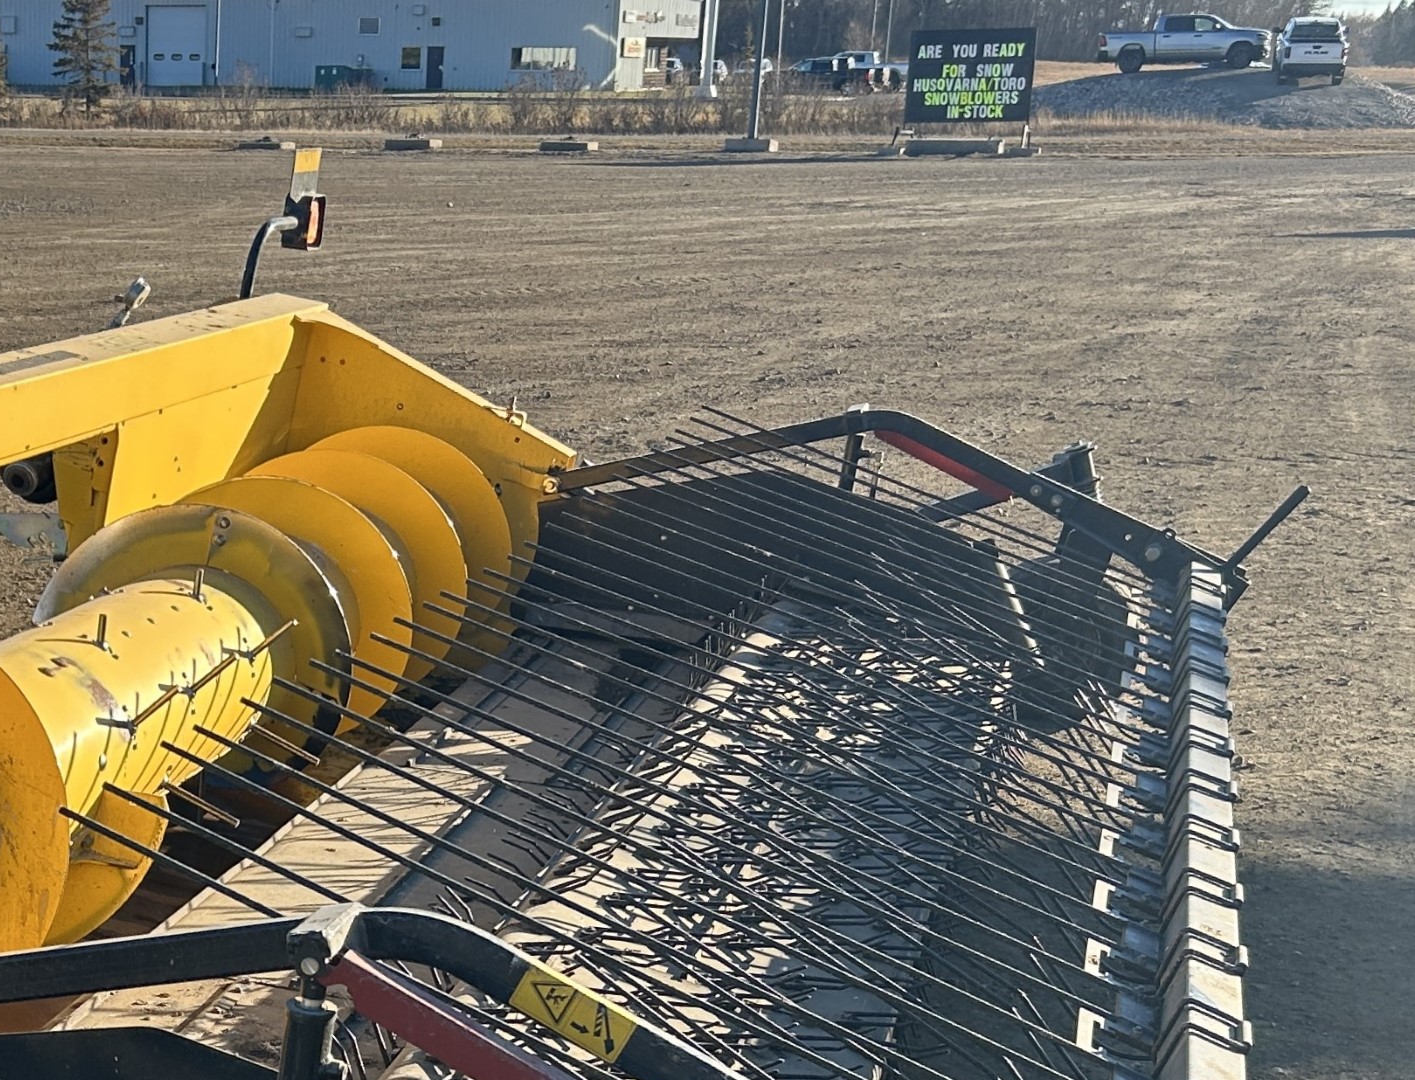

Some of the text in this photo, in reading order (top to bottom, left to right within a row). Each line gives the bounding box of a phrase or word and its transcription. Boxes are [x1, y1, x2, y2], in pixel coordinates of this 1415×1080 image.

[917, 42, 1026, 59] ARE YOU READY
[942, 63, 1014, 78] FOR SNOW
[912, 77, 1026, 92] HUSQVARNA/TORO
[924, 91, 1019, 106] SNOWBLOWERS
[946, 105, 1004, 119] IN-STOCK
